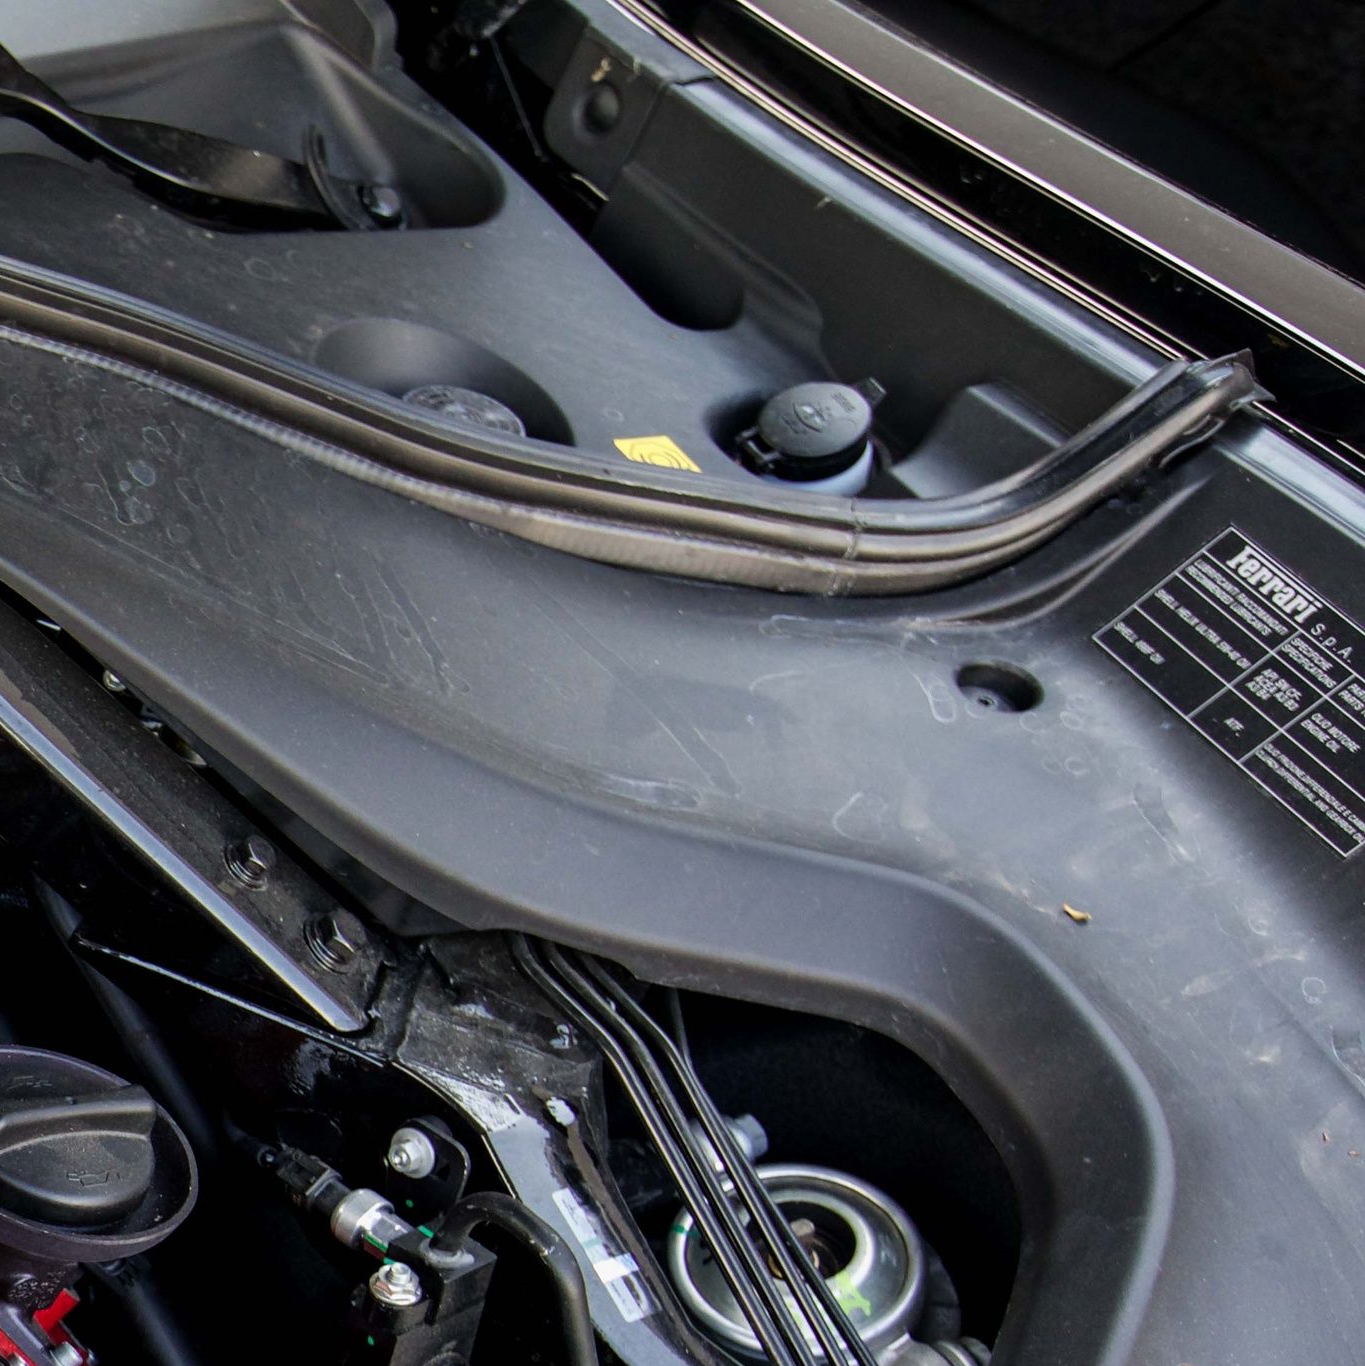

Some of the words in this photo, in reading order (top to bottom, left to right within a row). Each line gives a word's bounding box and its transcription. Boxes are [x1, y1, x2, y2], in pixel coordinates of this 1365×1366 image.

[1226, 545, 1323, 624] Ferrari
[1305, 624, 1352, 667] S.p.A.
[1280, 642, 1337, 688] SPECIFICATIONS
[1291, 636, 1333, 671] SPECIFICHE
[1338, 690, 1365, 711] PARTS
[1301, 719, 1331, 743] ENGINE
[1327, 726, 1361, 753] MOTORE
